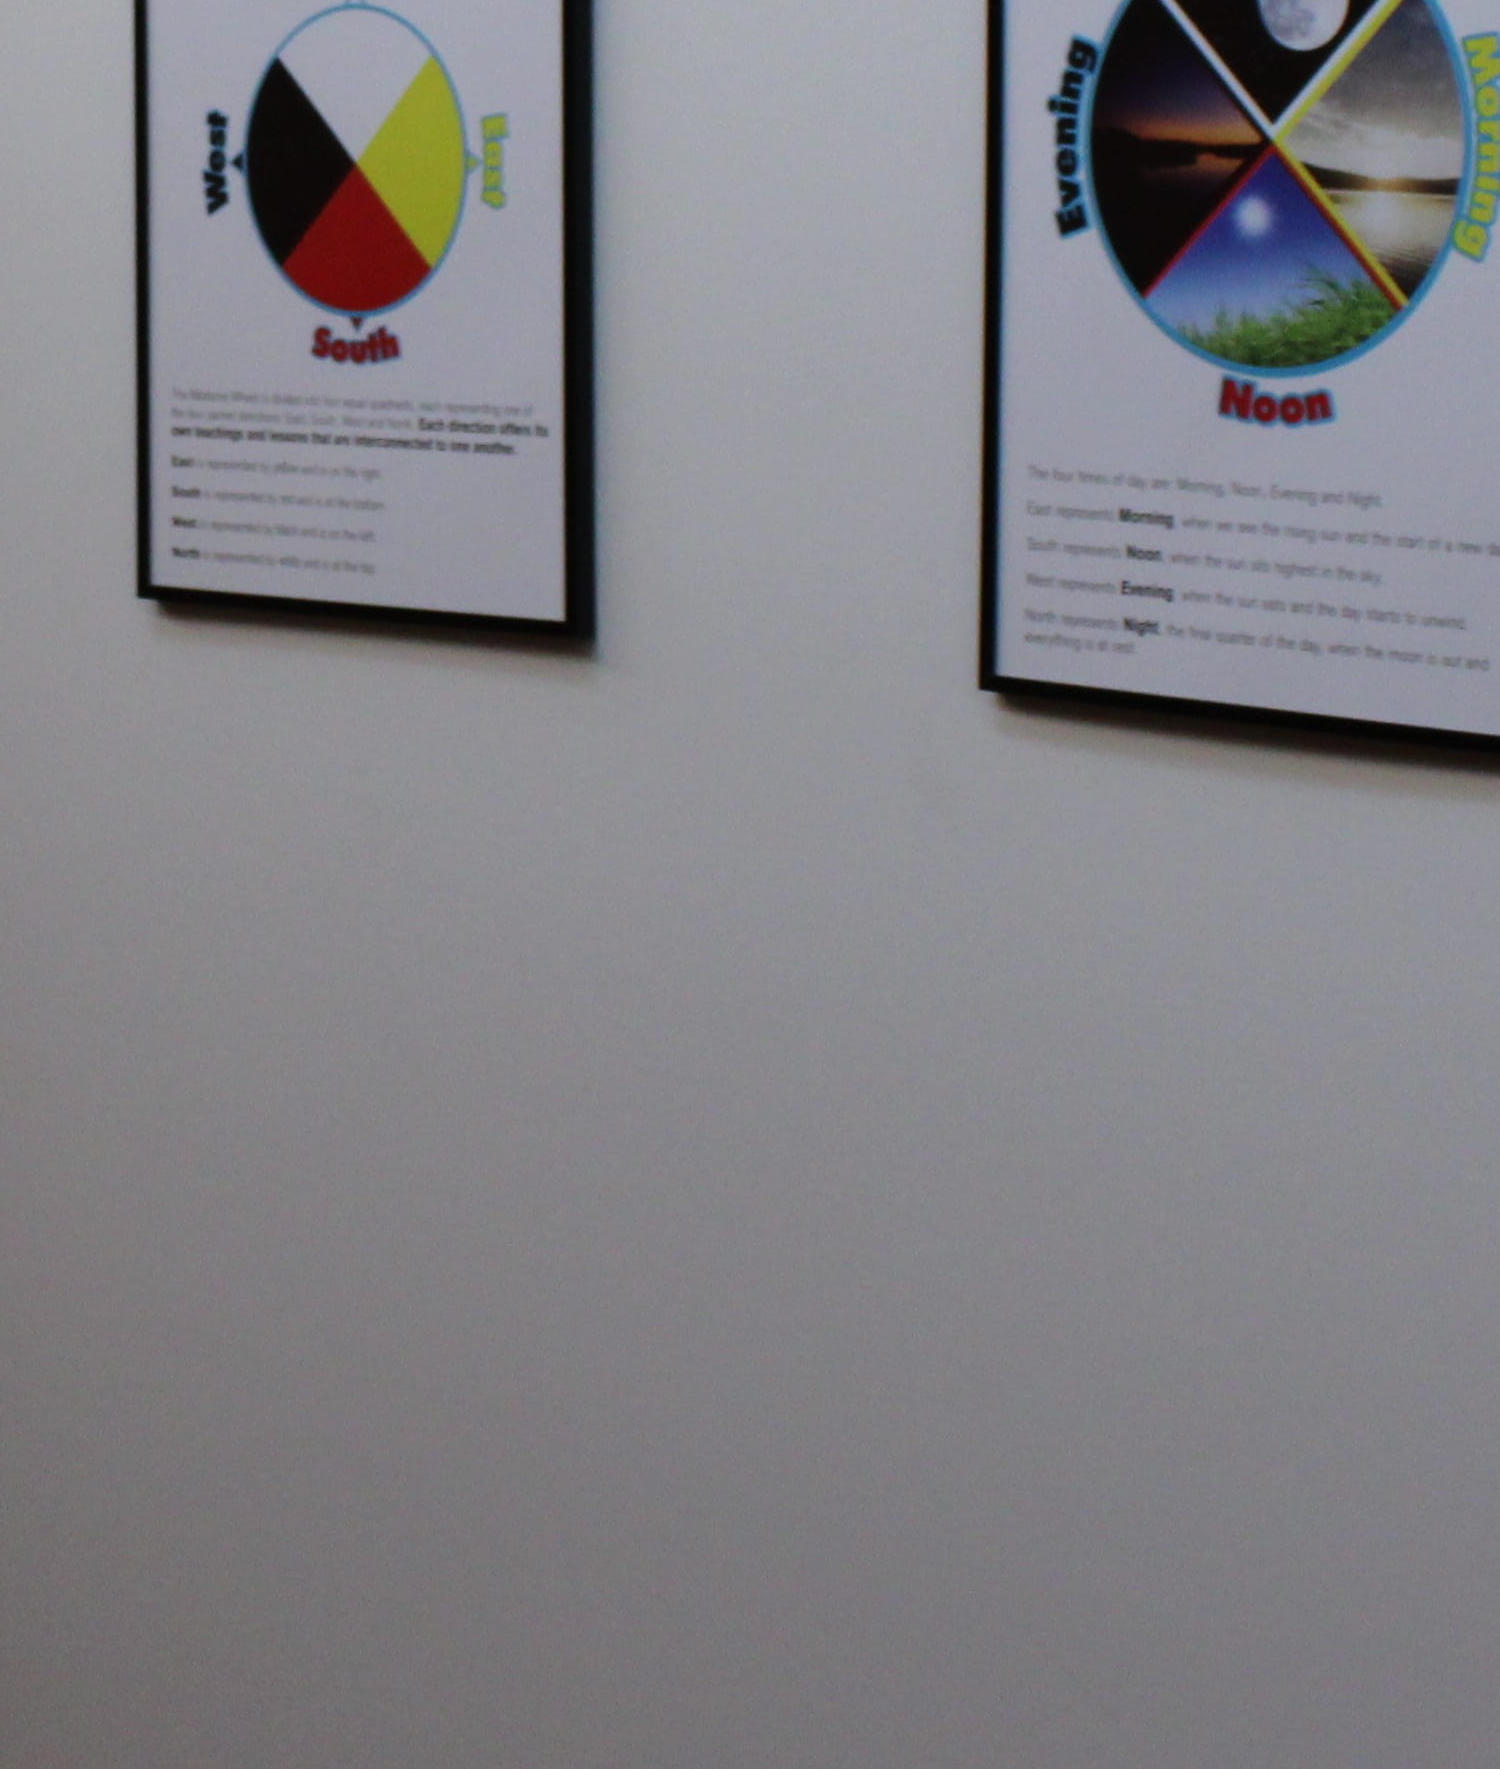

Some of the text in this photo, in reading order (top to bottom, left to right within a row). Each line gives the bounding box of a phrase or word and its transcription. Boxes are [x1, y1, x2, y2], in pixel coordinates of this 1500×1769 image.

[202, 108, 231, 217] West
[479, 112, 511, 209] East
[1046, 34, 1099, 240] Evening
[311, 326, 402, 365] South
[1217, 376, 1335, 427] Noon
